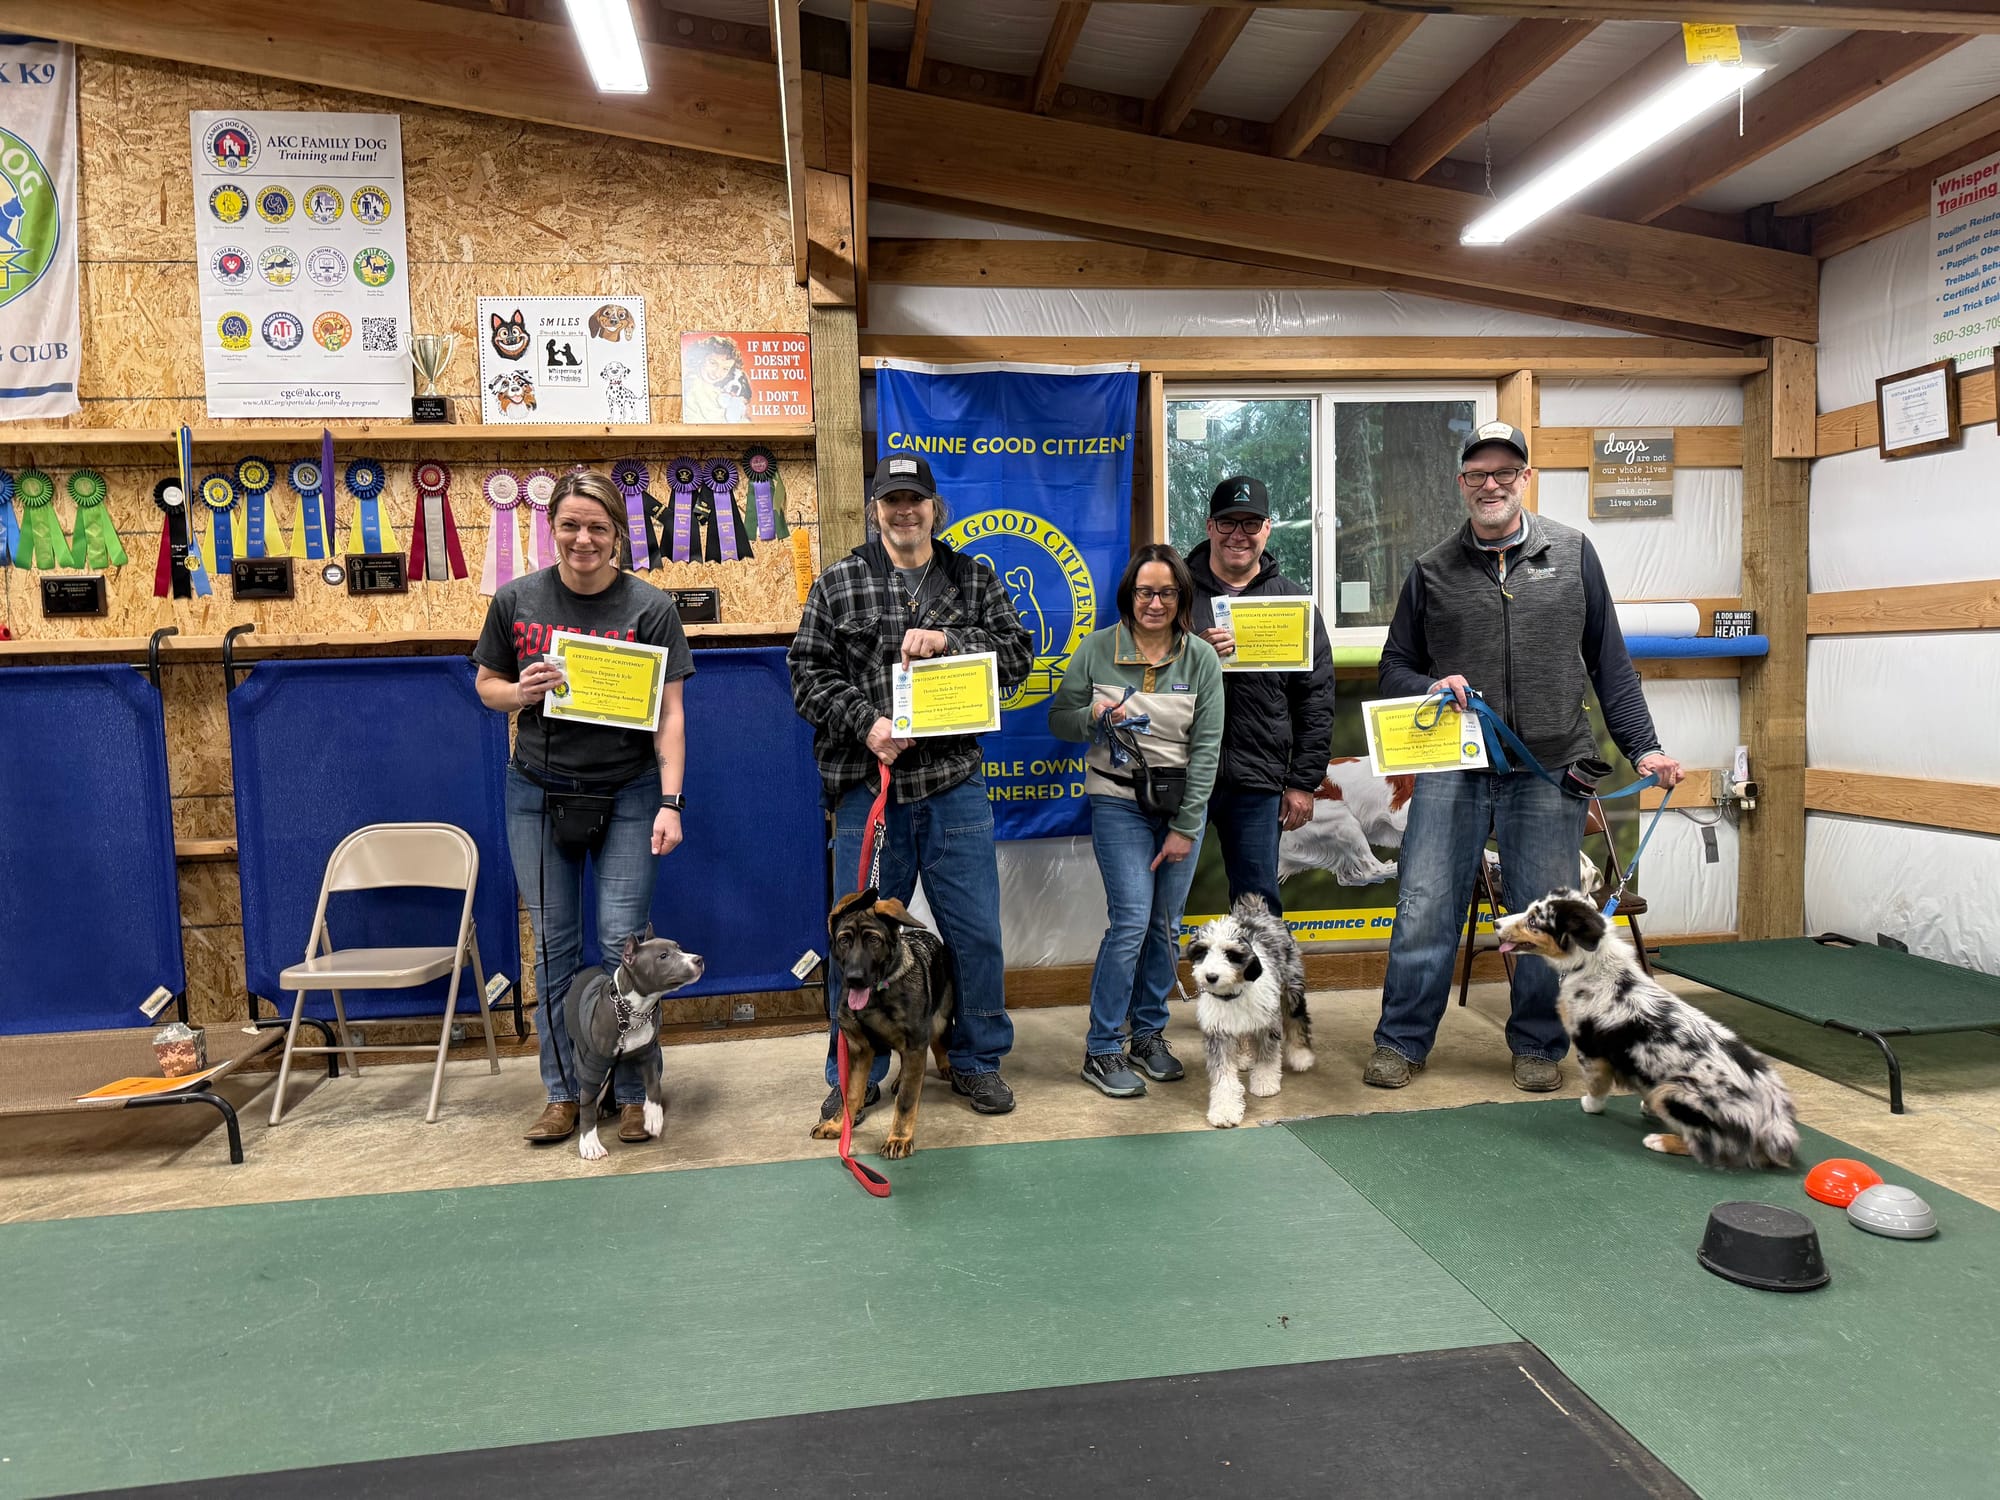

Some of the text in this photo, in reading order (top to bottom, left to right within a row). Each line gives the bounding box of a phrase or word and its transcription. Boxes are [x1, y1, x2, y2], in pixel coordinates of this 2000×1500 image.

[18, 63, 56, 85] K9
[207, 122, 224, 140] FAMILY
[240, 125, 257, 154] PROGRAM
[267, 136, 387, 150] AKC FAMILY DOG
[279, 150, 377, 163] Training and Fun!
[1938, 161, 2000, 197] Whisper
[1937, 182, 1998, 214] Training
[1969, 212, 2000, 227] Reinfo
[1937, 228, 2000, 257] and private cla
[217, 247, 244, 257] THERAPY
[267, 246, 288, 255] TRICK
[378, 249, 392, 265] DOG
[1980, 245, 2000, 256] Obe
[1982, 261, 2000, 273] Beha
[1943, 276, 1997, 302] Certified AKC
[1943, 292, 2000, 318] and Trick Eval
[540, 317, 580, 326] SMILES
[273, 321, 291, 337] ATT
[10, 342, 69, 364] CLUB
[747, 341, 806, 352] IF MY DOG
[754, 355, 801, 366] DOESN'T
[750, 369, 807, 382] LIKE YOU,
[280, 388, 341, 400] cgc@akc.org
[758, 390, 799, 402] I DON'T
[752, 404, 808, 416] LIKE YOU.
[887, 432, 967, 454] CANINE
[972, 437, 1036, 455] GOOD
[1604, 432, 1650, 464] dogs
[1653, 454, 1667, 462] not
[1620, 466, 1642, 474] whole
[1645, 466, 1667, 474] lives
[1618, 475, 1652, 485] but they
[1637, 488, 1652, 496] our
[1609, 498, 1657, 507] lives whole
[962, 513, 1093, 629] GOOD CITIZEN
[1715, 625, 1751, 638] HEART
[981, 761, 1025, 777] IBLE
[1070, 782, 1086, 798] D
[1370, 915, 1393, 928] do
